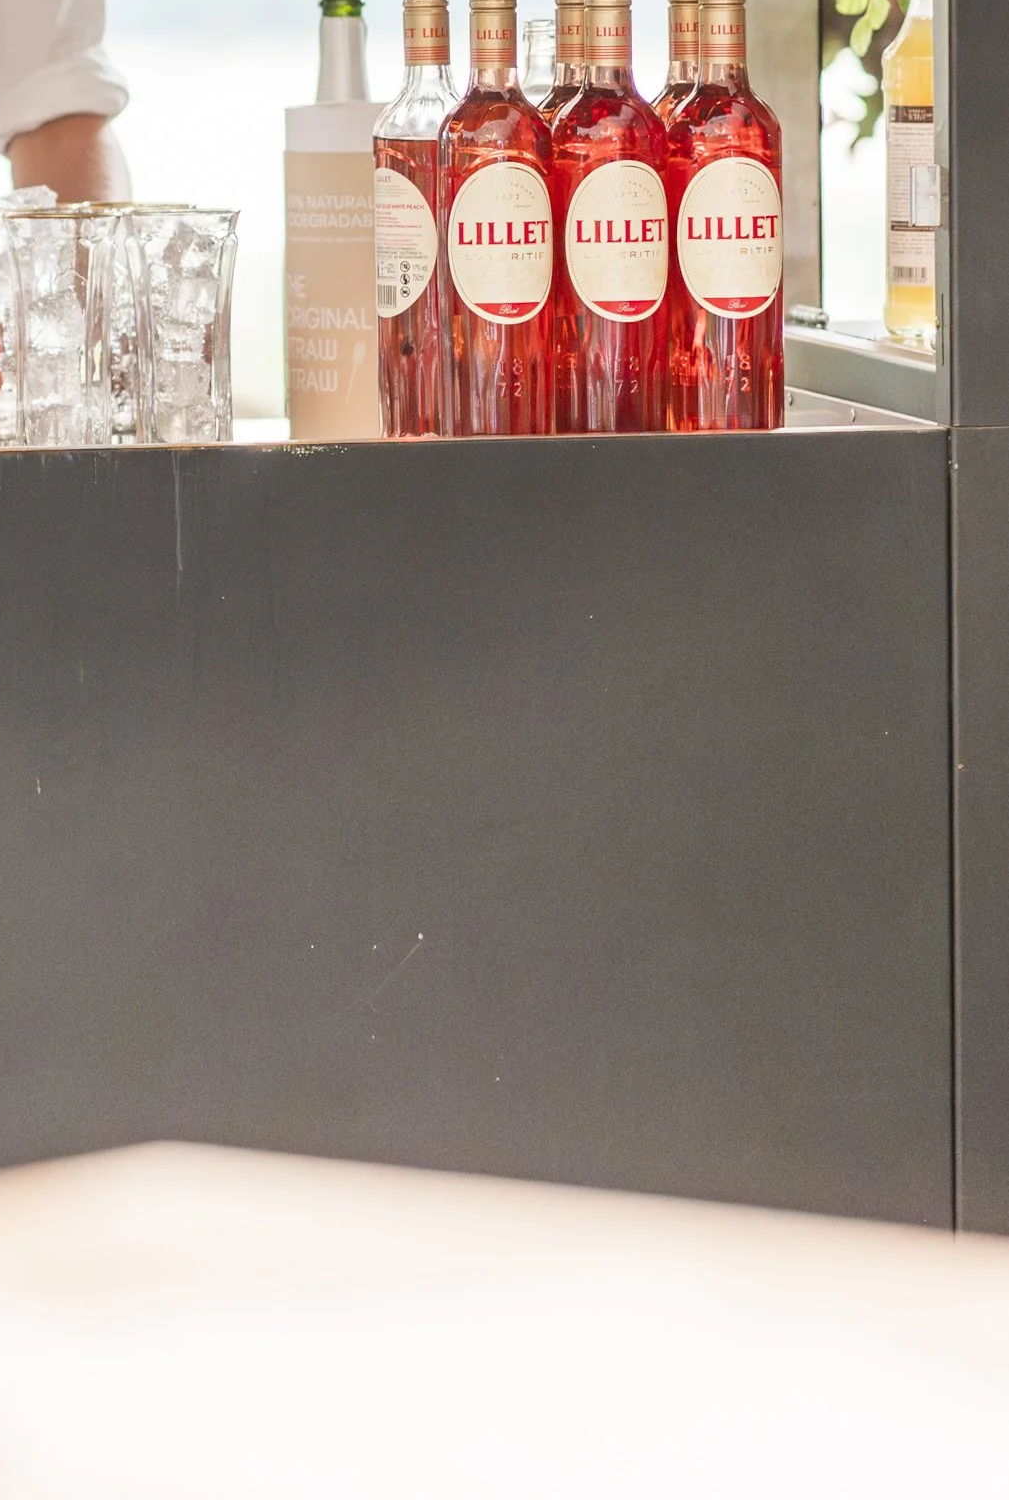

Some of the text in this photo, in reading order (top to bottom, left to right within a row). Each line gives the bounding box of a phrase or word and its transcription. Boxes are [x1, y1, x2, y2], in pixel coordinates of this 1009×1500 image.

[457, 220, 548, 245] LILLET
[576, 218, 665, 243] LILLET
[687, 215, 778, 240] LILLET
[288, 337, 338, 362] TRAW
[289, 368, 339, 393] TRAW
